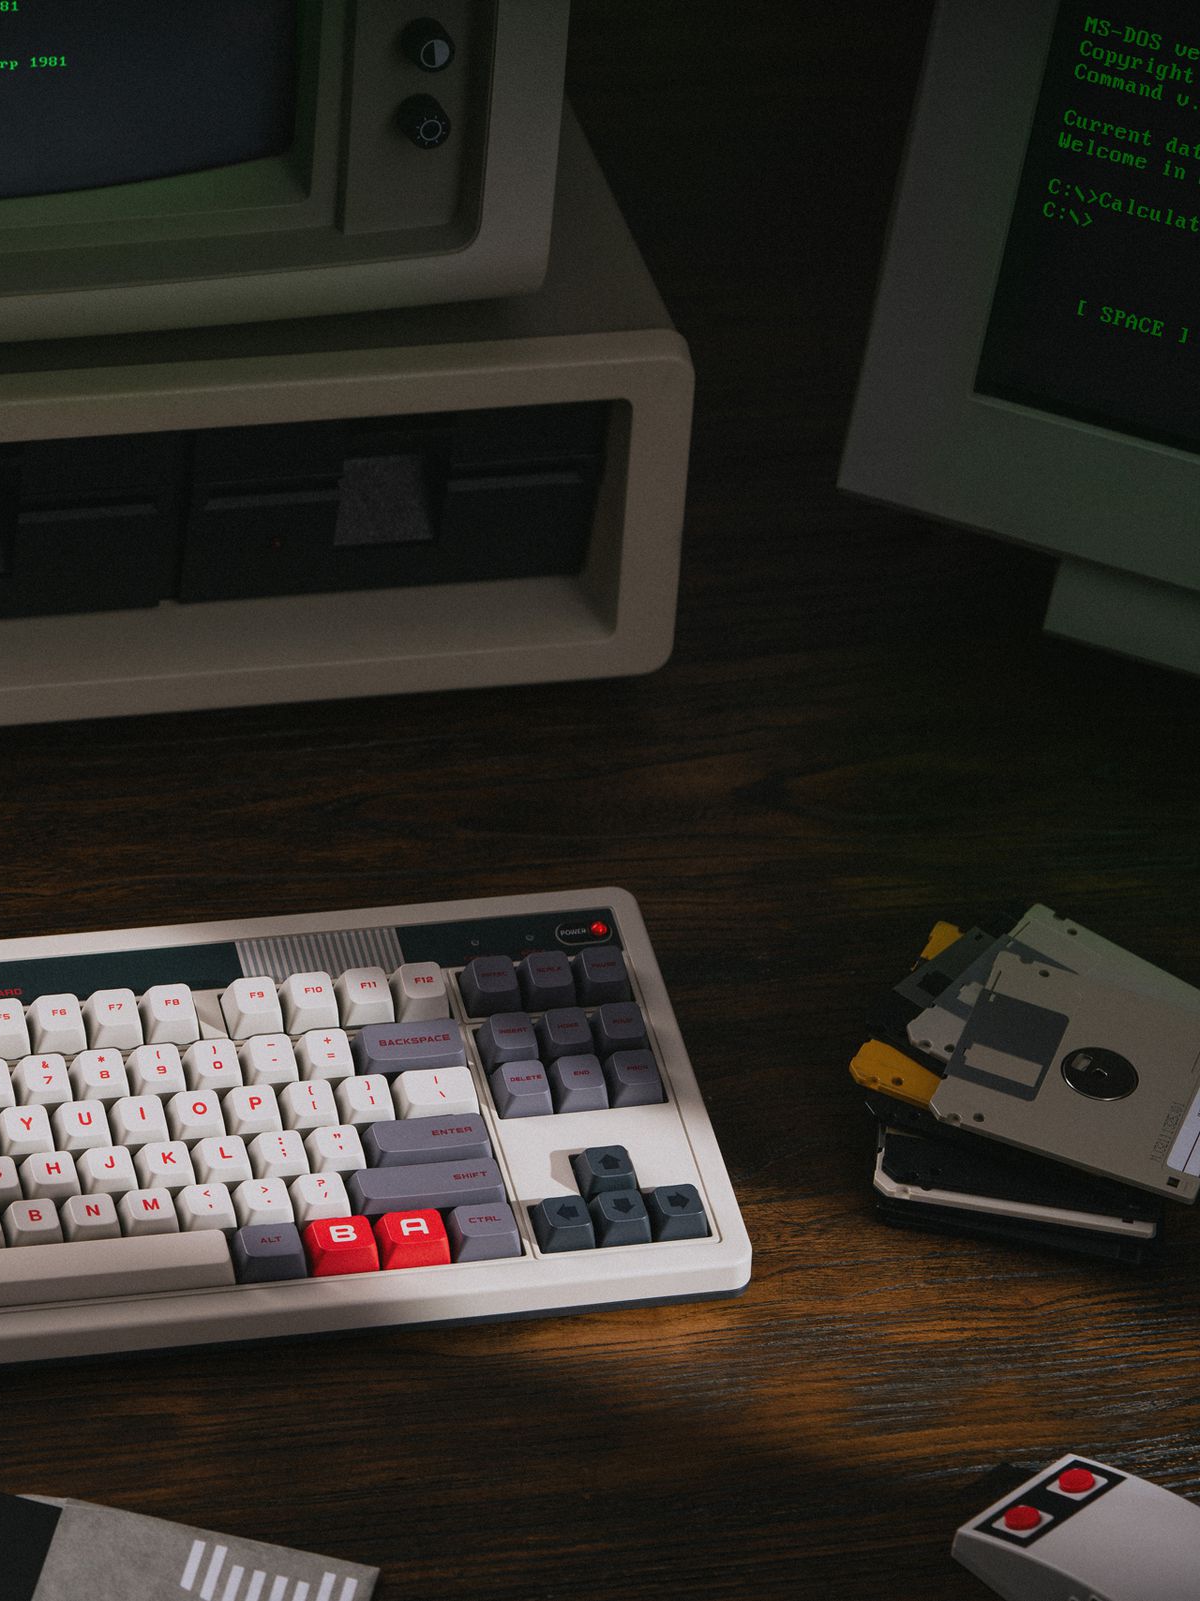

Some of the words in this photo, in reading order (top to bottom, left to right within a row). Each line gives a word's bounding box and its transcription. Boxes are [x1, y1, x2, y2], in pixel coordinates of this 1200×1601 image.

[1084, 16, 1162, 51] MS-DOS
[31, 55, 65, 69] 1981
[1079, 40, 1193, 84] Copyright
[1074, 63, 1163, 100] Command
[1176, 95, 1198, 111] v.
[1063, 108, 1151, 146] Current
[1058, 131, 1148, 169] Welcome
[1163, 160, 1185, 180] in
[1042, 201, 1092, 226] C:\>
[1099, 306, 1164, 337] SPACE
[560, 928, 586, 936] POWER
[304, 986, 323, 994] F10
[360, 981, 376, 989] F11
[499, 1027, 528, 1035] INSERT
[378, 1033, 450, 1046] BACKSPACE
[157, 1066, 167, 1074] 9
[213, 1061, 223, 1070] 0
[43, 1075, 52, 1084] 7
[100, 1070, 110, 1078] 8
[192, 1102, 207, 1115] O
[249, 1096, 262, 1110] P
[78, 1112, 92, 1125] U
[140, 1107, 145, 1120] I
[20, 1117, 32, 1130] Y
[432, 1127, 472, 1135] ENTER
[162, 1152, 176, 1164] K
[219, 1146, 232, 1159] L
[45, 1162, 61, 1174] H
[104, 1156, 115, 1168] J
[453, 1171, 487, 1181] SHIFT
[86, 1205, 100, 1216] N
[142, 1199, 159, 1210] M
[28, 1210, 42, 1222] B
[400, 1218, 428, 1235] A
[261, 1235, 281, 1244] ALT
[330, 1225, 356, 1242] B
